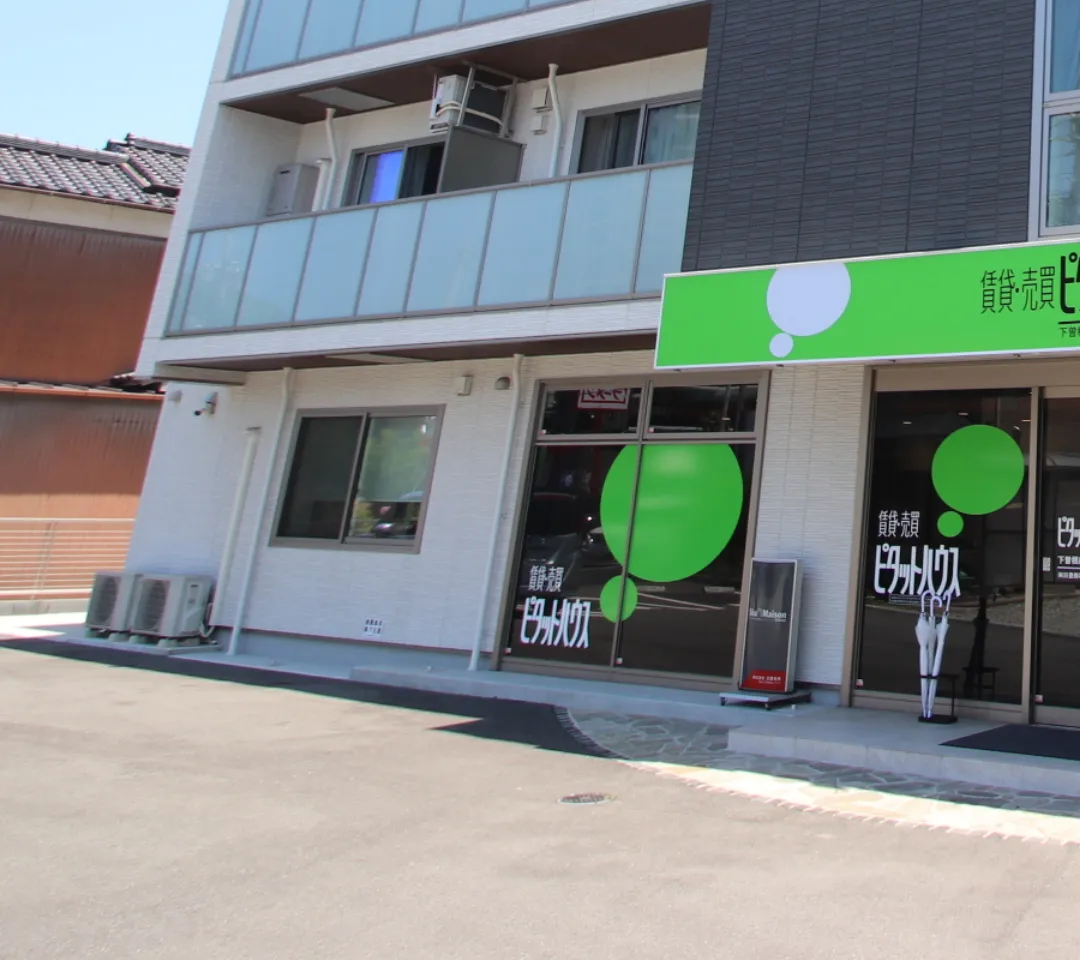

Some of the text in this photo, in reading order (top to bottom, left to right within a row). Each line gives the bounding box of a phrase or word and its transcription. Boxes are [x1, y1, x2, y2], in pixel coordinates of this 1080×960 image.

[980, 266, 1056, 314] 賃貸・売買
[878, 510, 920, 538] 賃貸・売買
[874, 543, 962, 597] ピタットハウス
[520, 595, 592, 649] ピタットハウス
